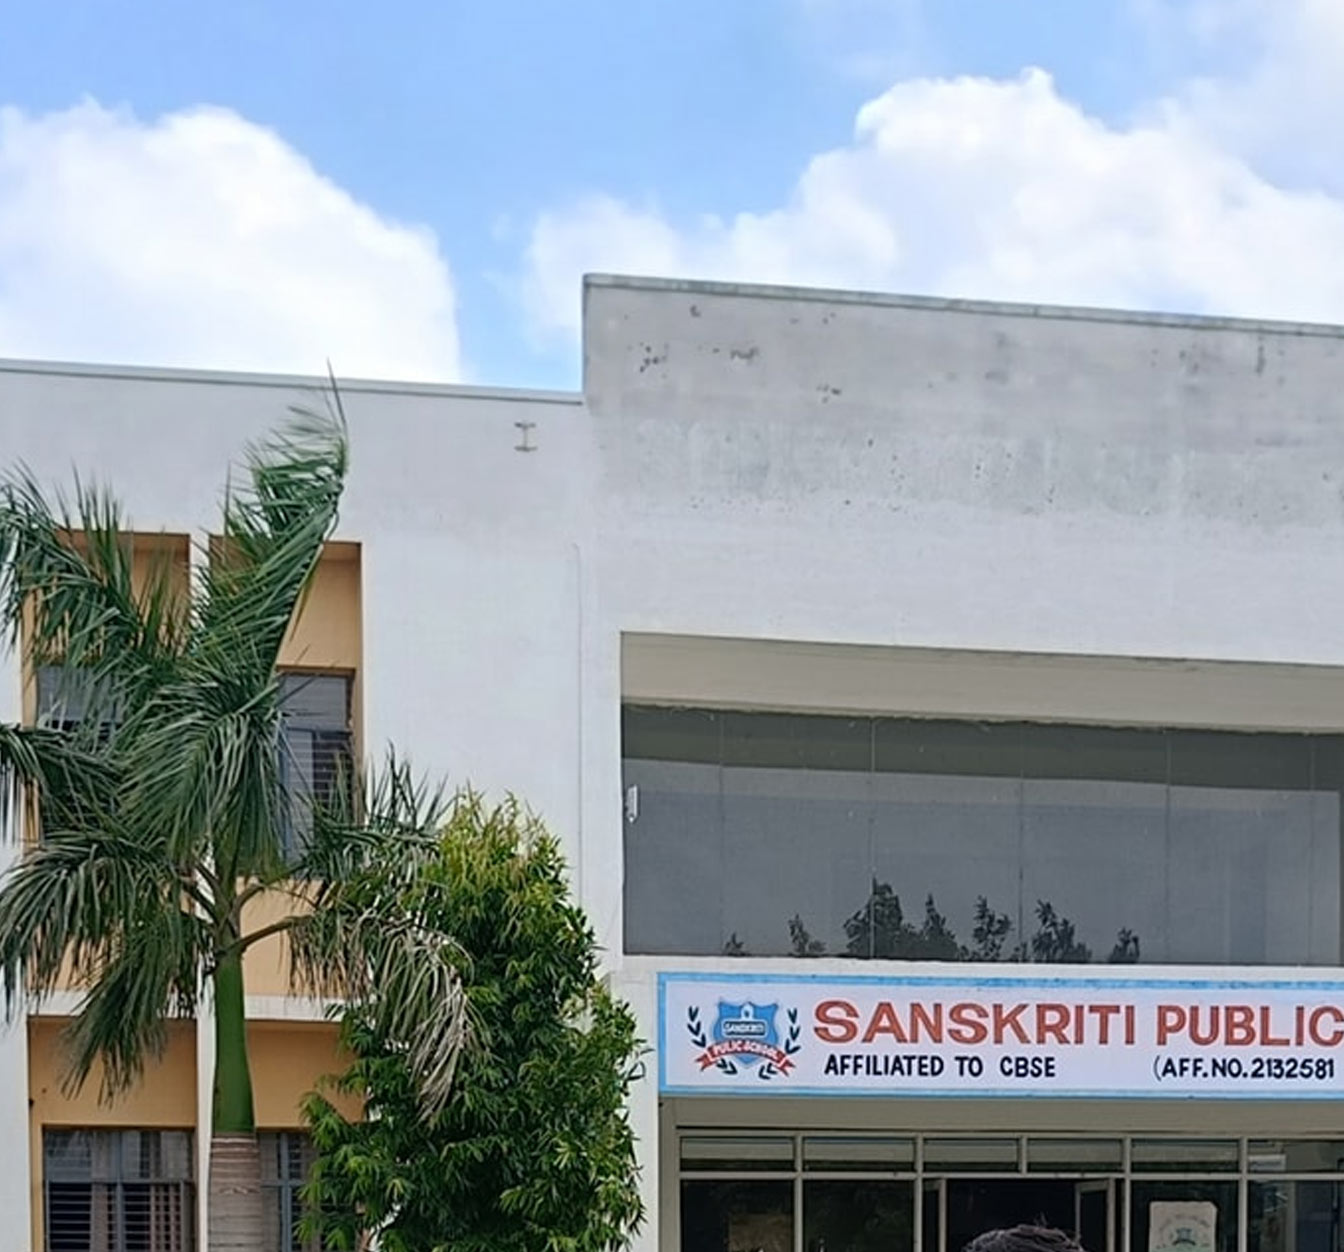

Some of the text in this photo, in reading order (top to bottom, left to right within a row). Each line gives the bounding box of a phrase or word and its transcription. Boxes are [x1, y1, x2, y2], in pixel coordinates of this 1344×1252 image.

[812, 999, 1136, 1046] SANSKRITI
[824, 1054, 1056, 1078] AFFILIATED TO CBSE
